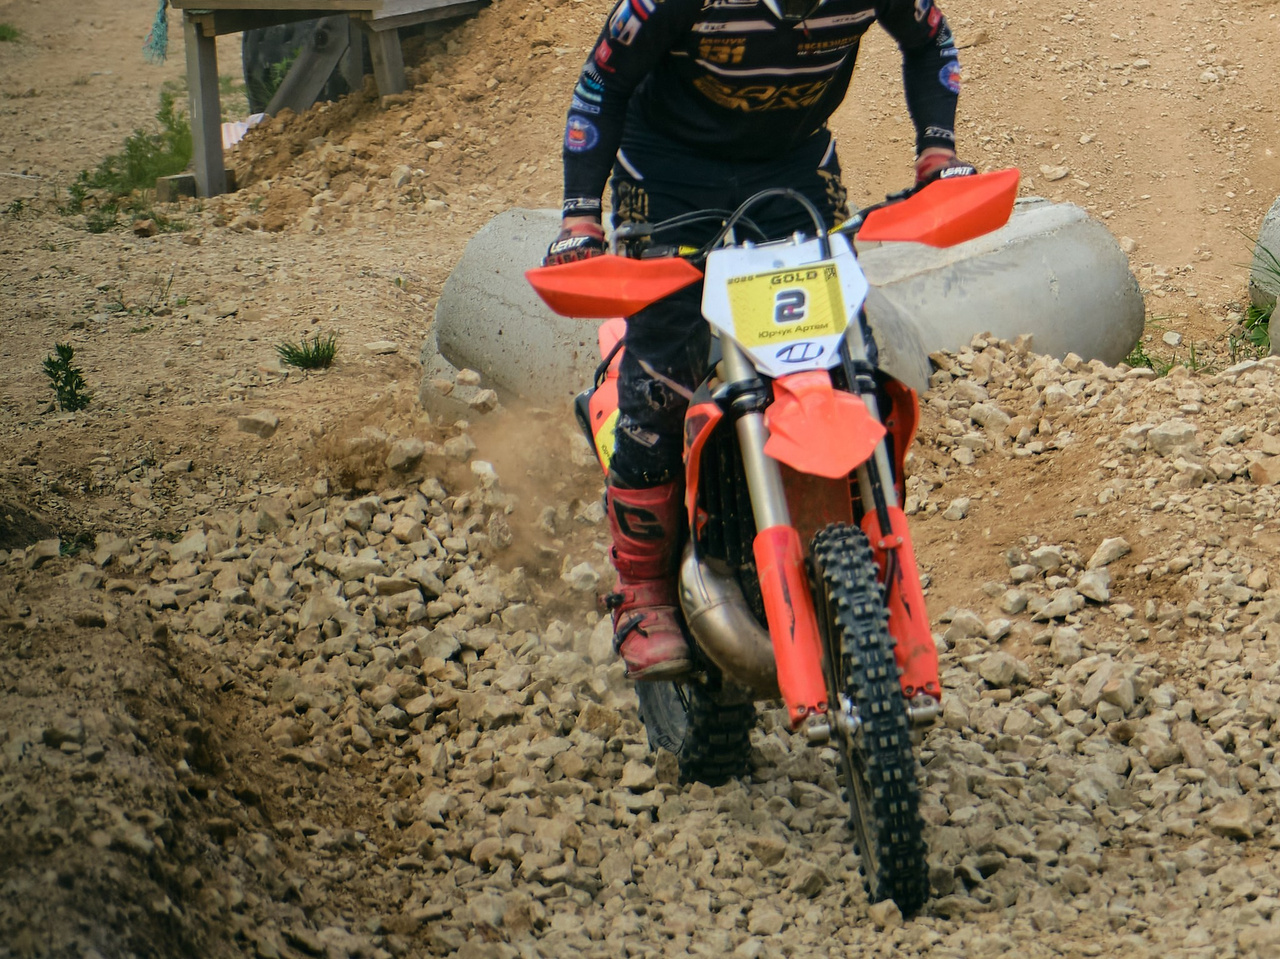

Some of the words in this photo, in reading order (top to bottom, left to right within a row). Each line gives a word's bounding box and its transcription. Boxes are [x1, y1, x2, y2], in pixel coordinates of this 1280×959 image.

[941, 166, 973, 179] LEATT
[550, 236, 590, 254] LEATT
[770, 270, 818, 286] GOLD
[774, 288, 806, 324] 2
[758, 327, 792, 339] Юрчук
